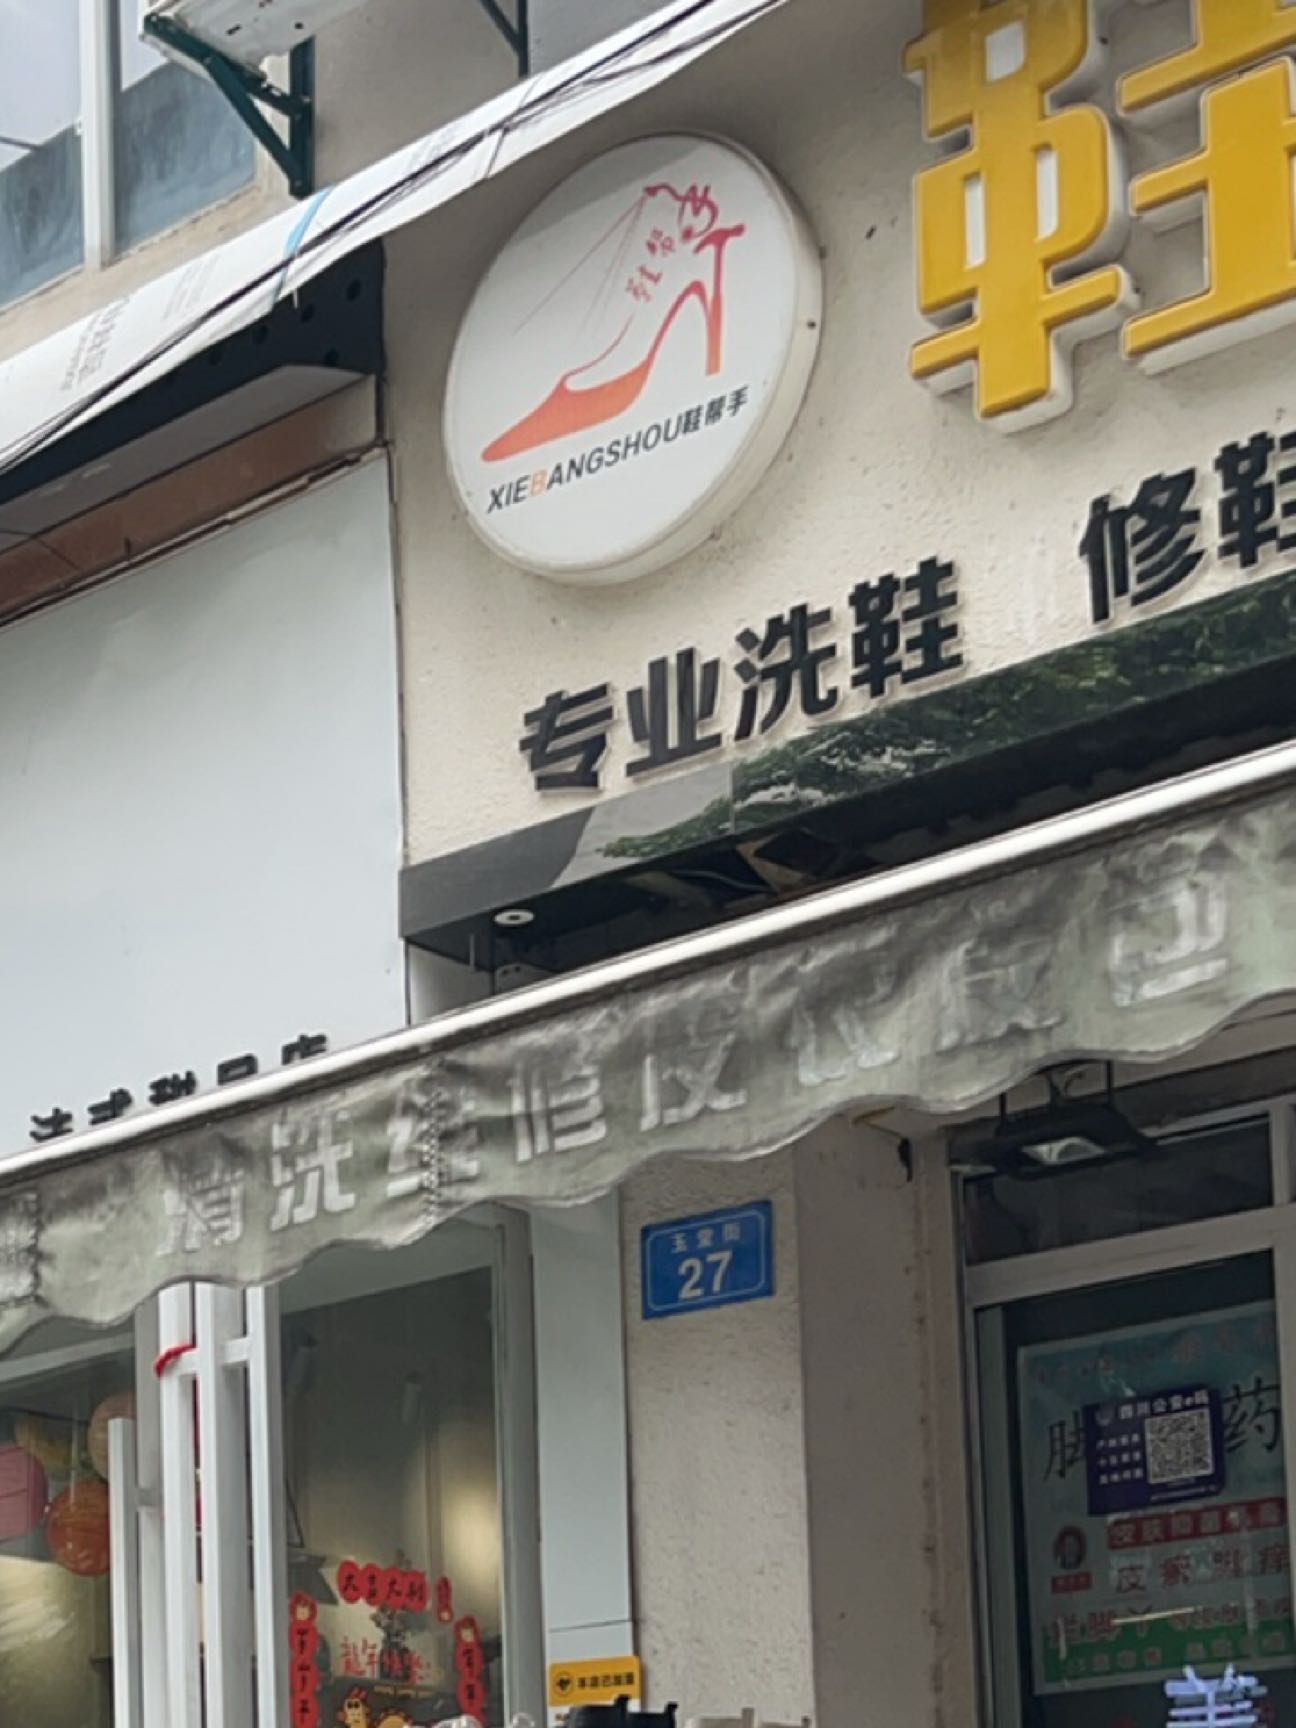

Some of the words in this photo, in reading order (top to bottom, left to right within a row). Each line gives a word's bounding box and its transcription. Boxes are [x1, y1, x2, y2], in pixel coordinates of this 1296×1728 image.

[519, 556, 964, 792] 专业洗鞋
[677, 1250, 733, 1300] 27
